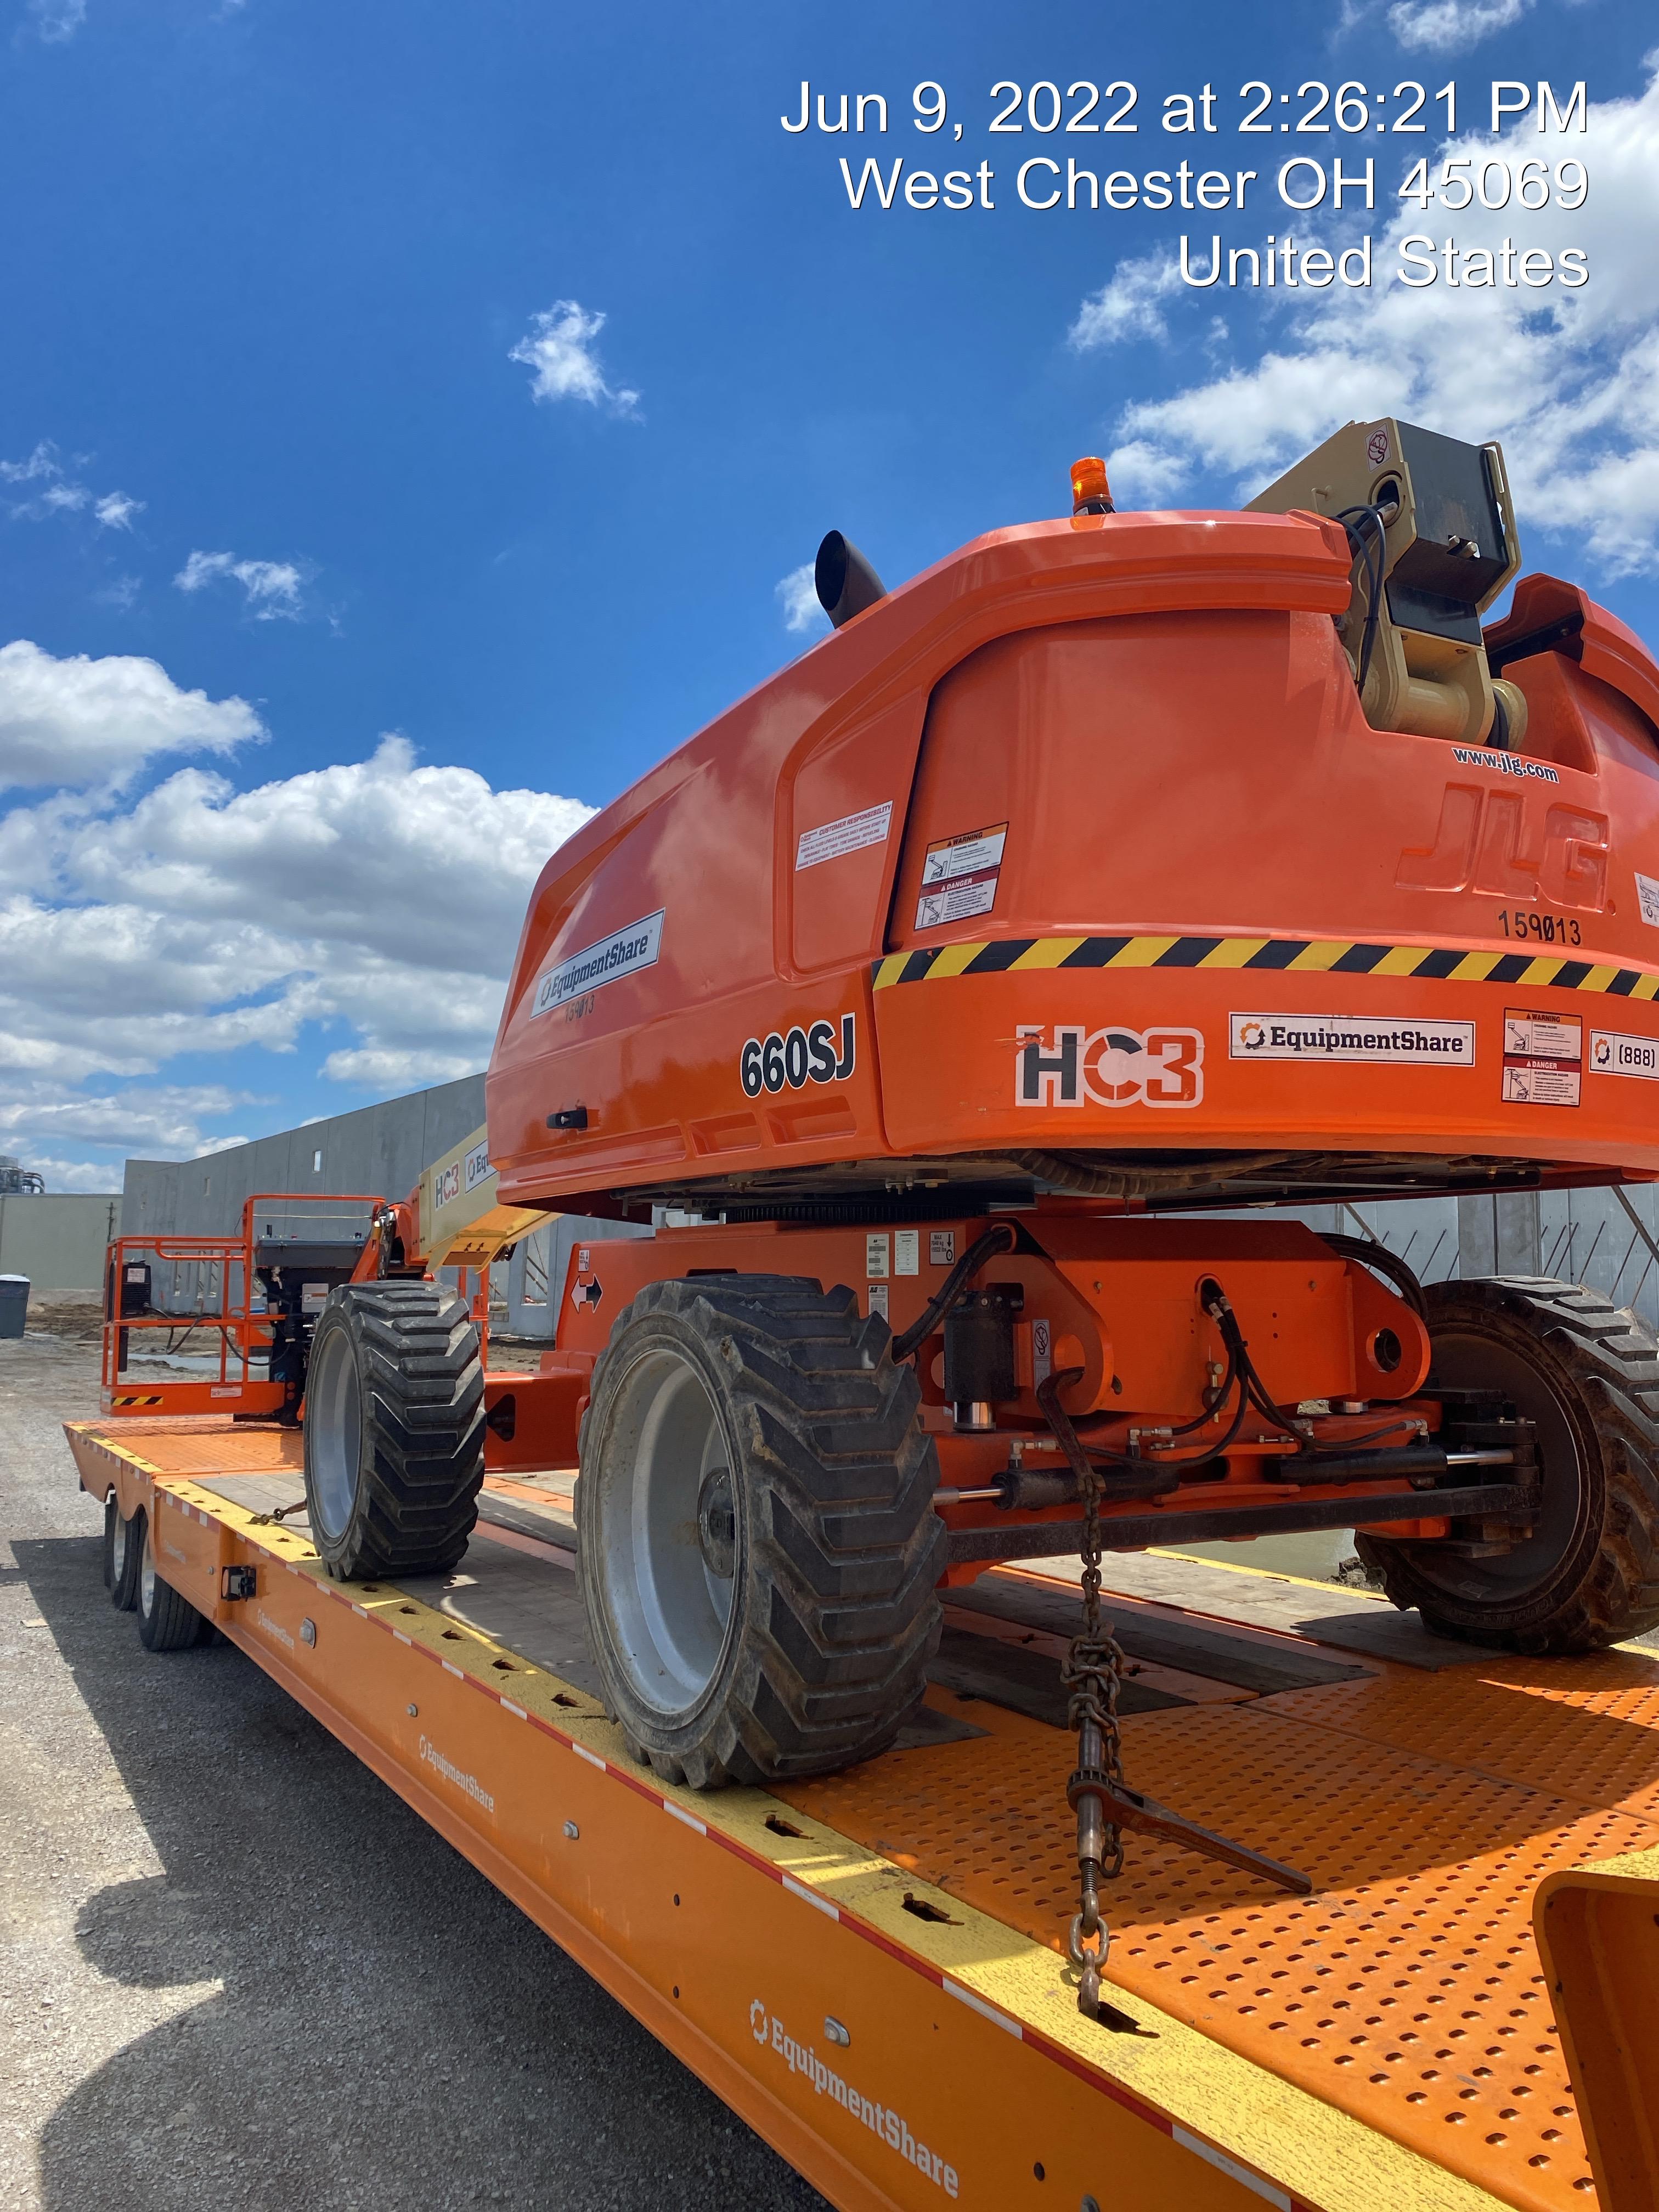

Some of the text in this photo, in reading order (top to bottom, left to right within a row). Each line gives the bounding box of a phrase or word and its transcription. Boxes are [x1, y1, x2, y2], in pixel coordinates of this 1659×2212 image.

[1452, 748, 1560, 783] www.jlg.com
[819, 804, 891, 836] CUSTOMER RESPONSIBILITY
[953, 832, 983, 845] WARNING
[1394, 781, 1610, 913] JLG
[946, 878, 973, 890] DANGER
[550, 935, 648, 999] EquipmentShare
[1532, 1013, 1560, 1023] WARNING
[741, 1012, 855, 1098] 660SJ
[1270, 1026, 1463, 1052] EquipmentShare
[1619, 1043, 1655, 1068] (888)
[1015, 1025, 1205, 1108] HC3
[1532, 1060, 1557, 1069] DANGER
[435, 1160, 460, 1211] HC3
[428, 1741, 494, 1813] EquipmentShare
[771, 2016, 959, 2199] EquipmentShare
